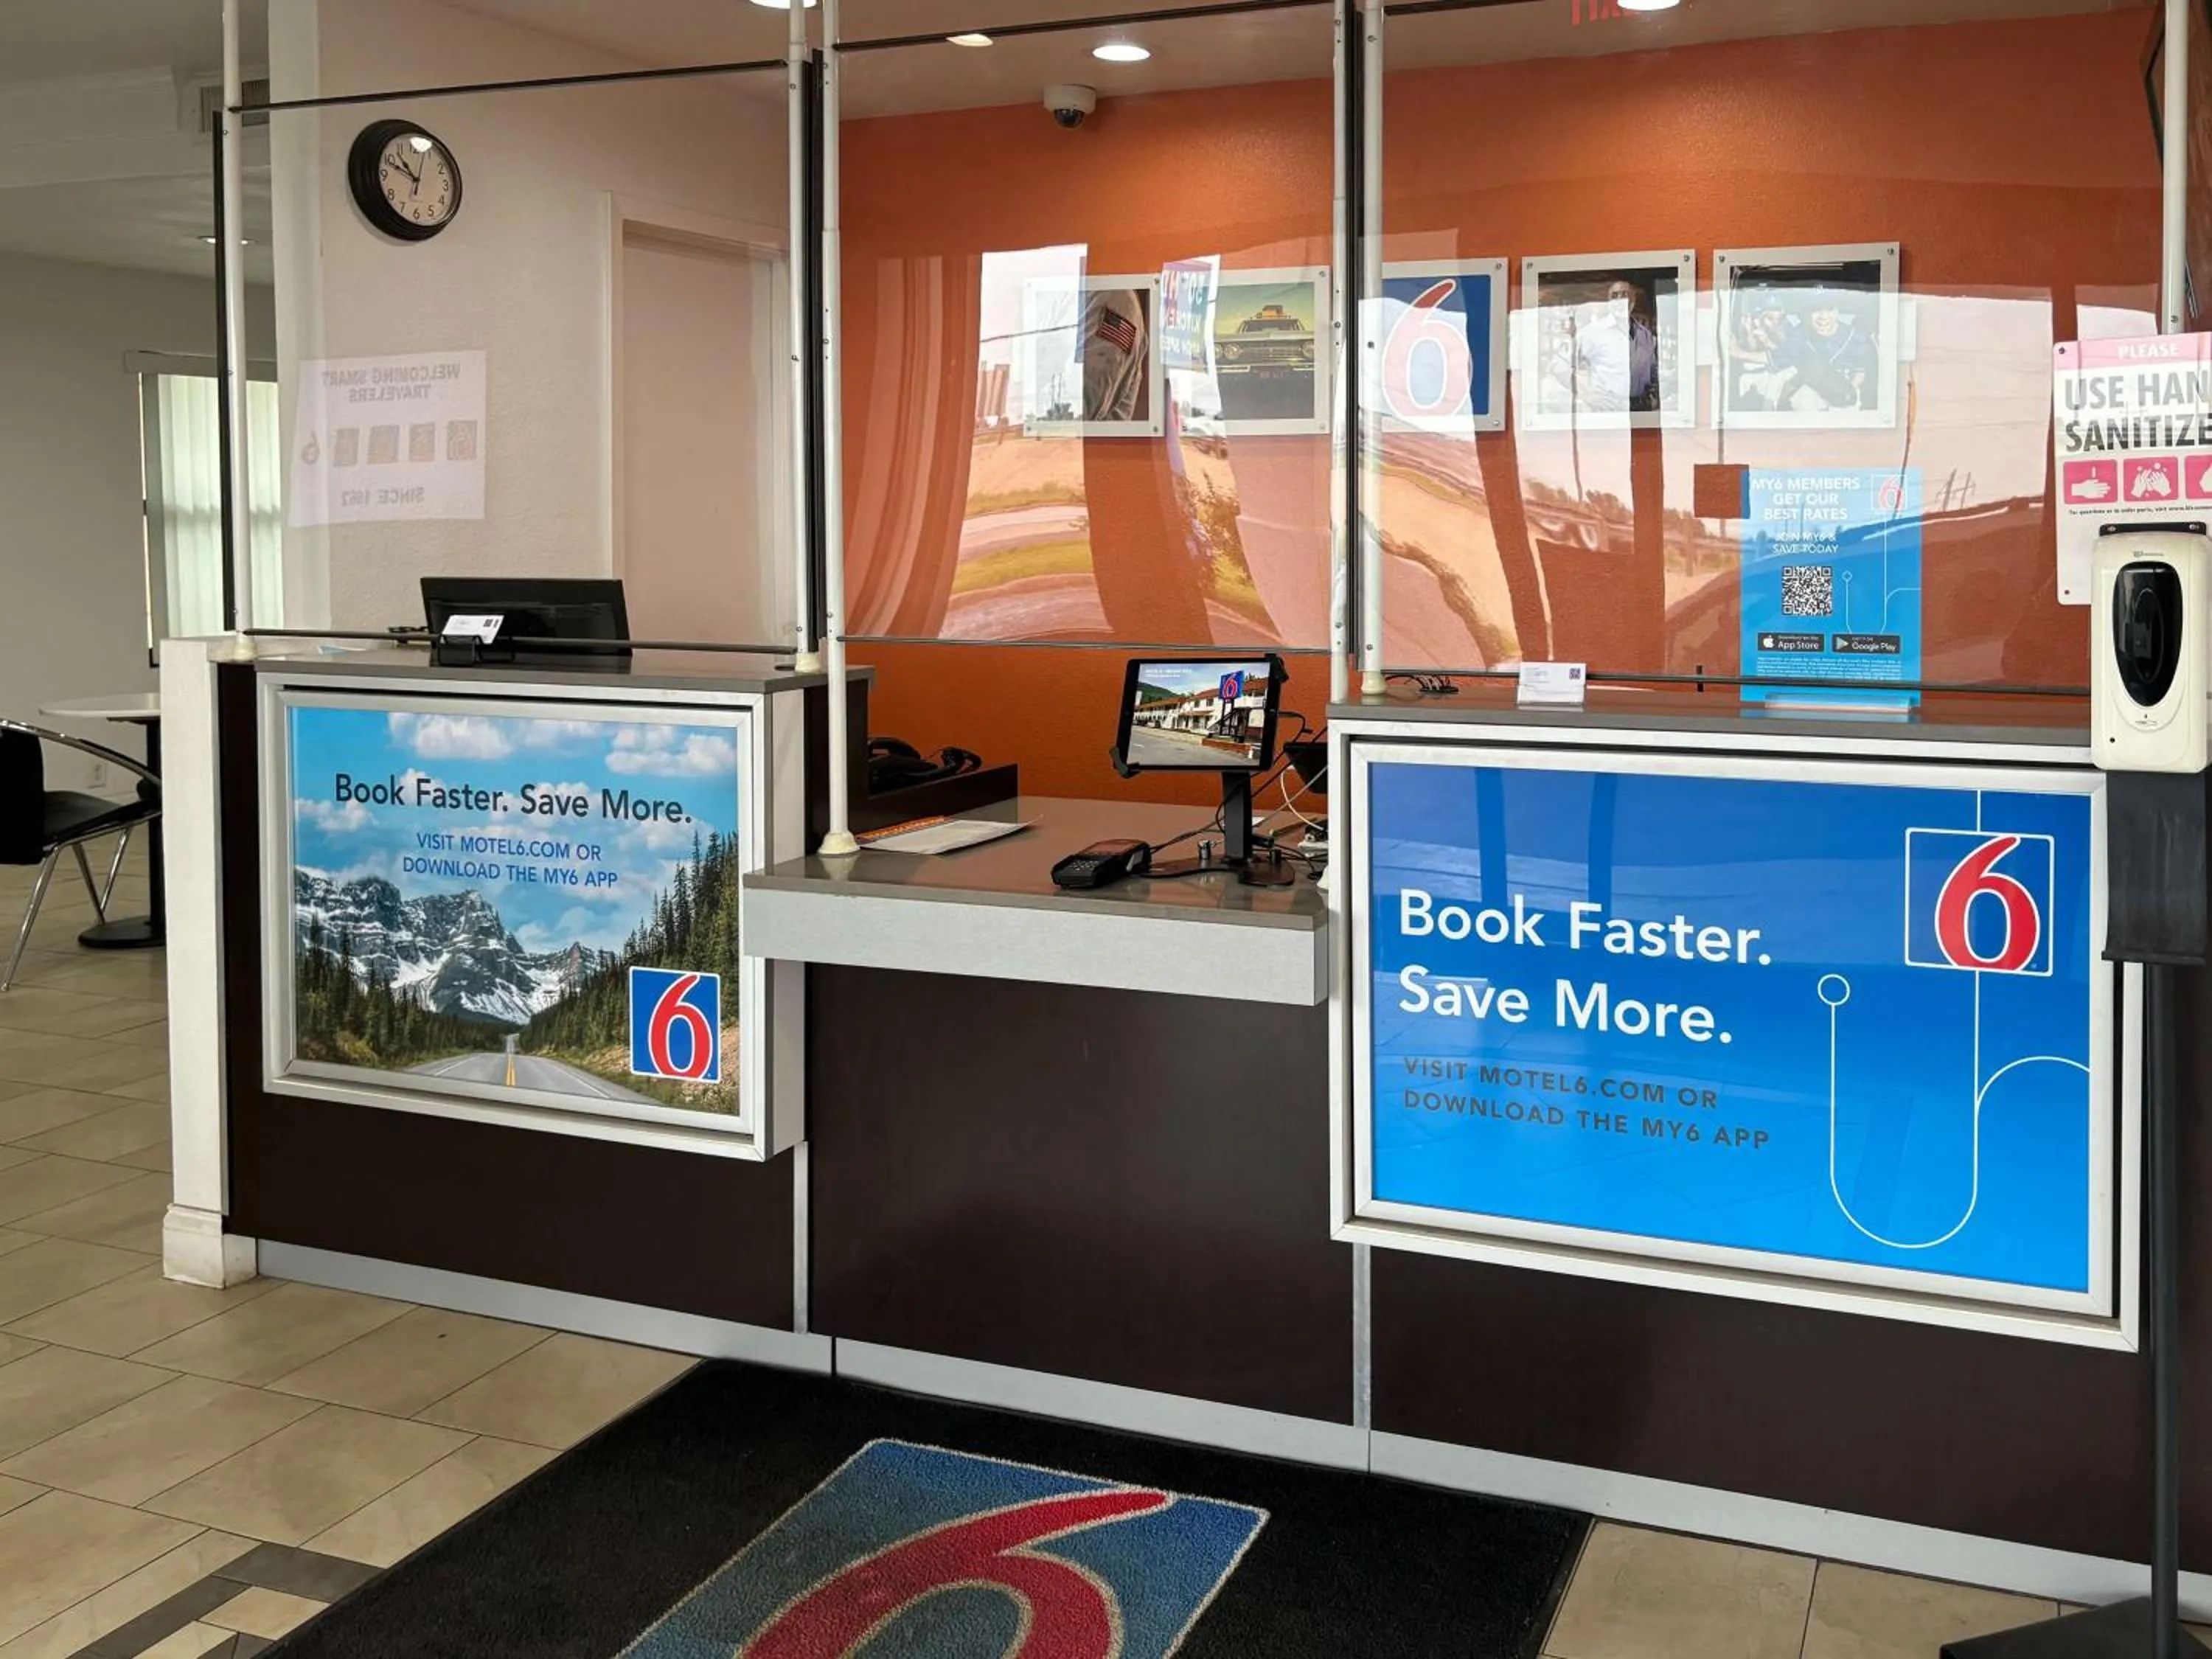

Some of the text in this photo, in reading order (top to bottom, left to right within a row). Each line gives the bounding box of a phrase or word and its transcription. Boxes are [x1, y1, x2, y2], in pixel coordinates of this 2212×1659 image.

[384, 153, 396, 165] 10
[380, 169, 389, 181] 9
[437, 162, 445, 175] 2
[442, 179, 449, 192] 3
[387, 188, 394, 201] 8
[438, 195, 445, 206] 4
[399, 201, 406, 213] 7
[428, 205, 434, 217] 5
[413, 208, 420, 220] 6
[1382, 277, 1472, 419] 6
[2118, 343, 2180, 359] PLEASE
[2065, 370, 2212, 411] USE HAN
[1752, 477, 1860, 491] MY6 MEMBERS
[1773, 493, 1839, 505] GET OUR
[1764, 507, 1848, 520] BEST RATES
[1772, 544, 1839, 554] SAVE TODAY
[1778, 641, 1819, 650] App Store
[1852, 641, 1896, 652] Google Play
[335, 773, 692, 824] Book Faster. Save More.
[417, 832, 602, 861] VISIT MOTEL6.COM OR
[403, 857, 618, 888] DOWNLOAD THE MY6 APP
[1934, 834, 2041, 971] 6
[1399, 888, 1771, 966] Book Faster.
[1398, 965, 1733, 1044] Save More.
[648, 973, 714, 1081] 6
[1403, 1057, 1718, 1110] VISIT MOTEL6.COM OR
[1403, 1089, 1770, 1150] DOWNLOAD THE MY6 APP
